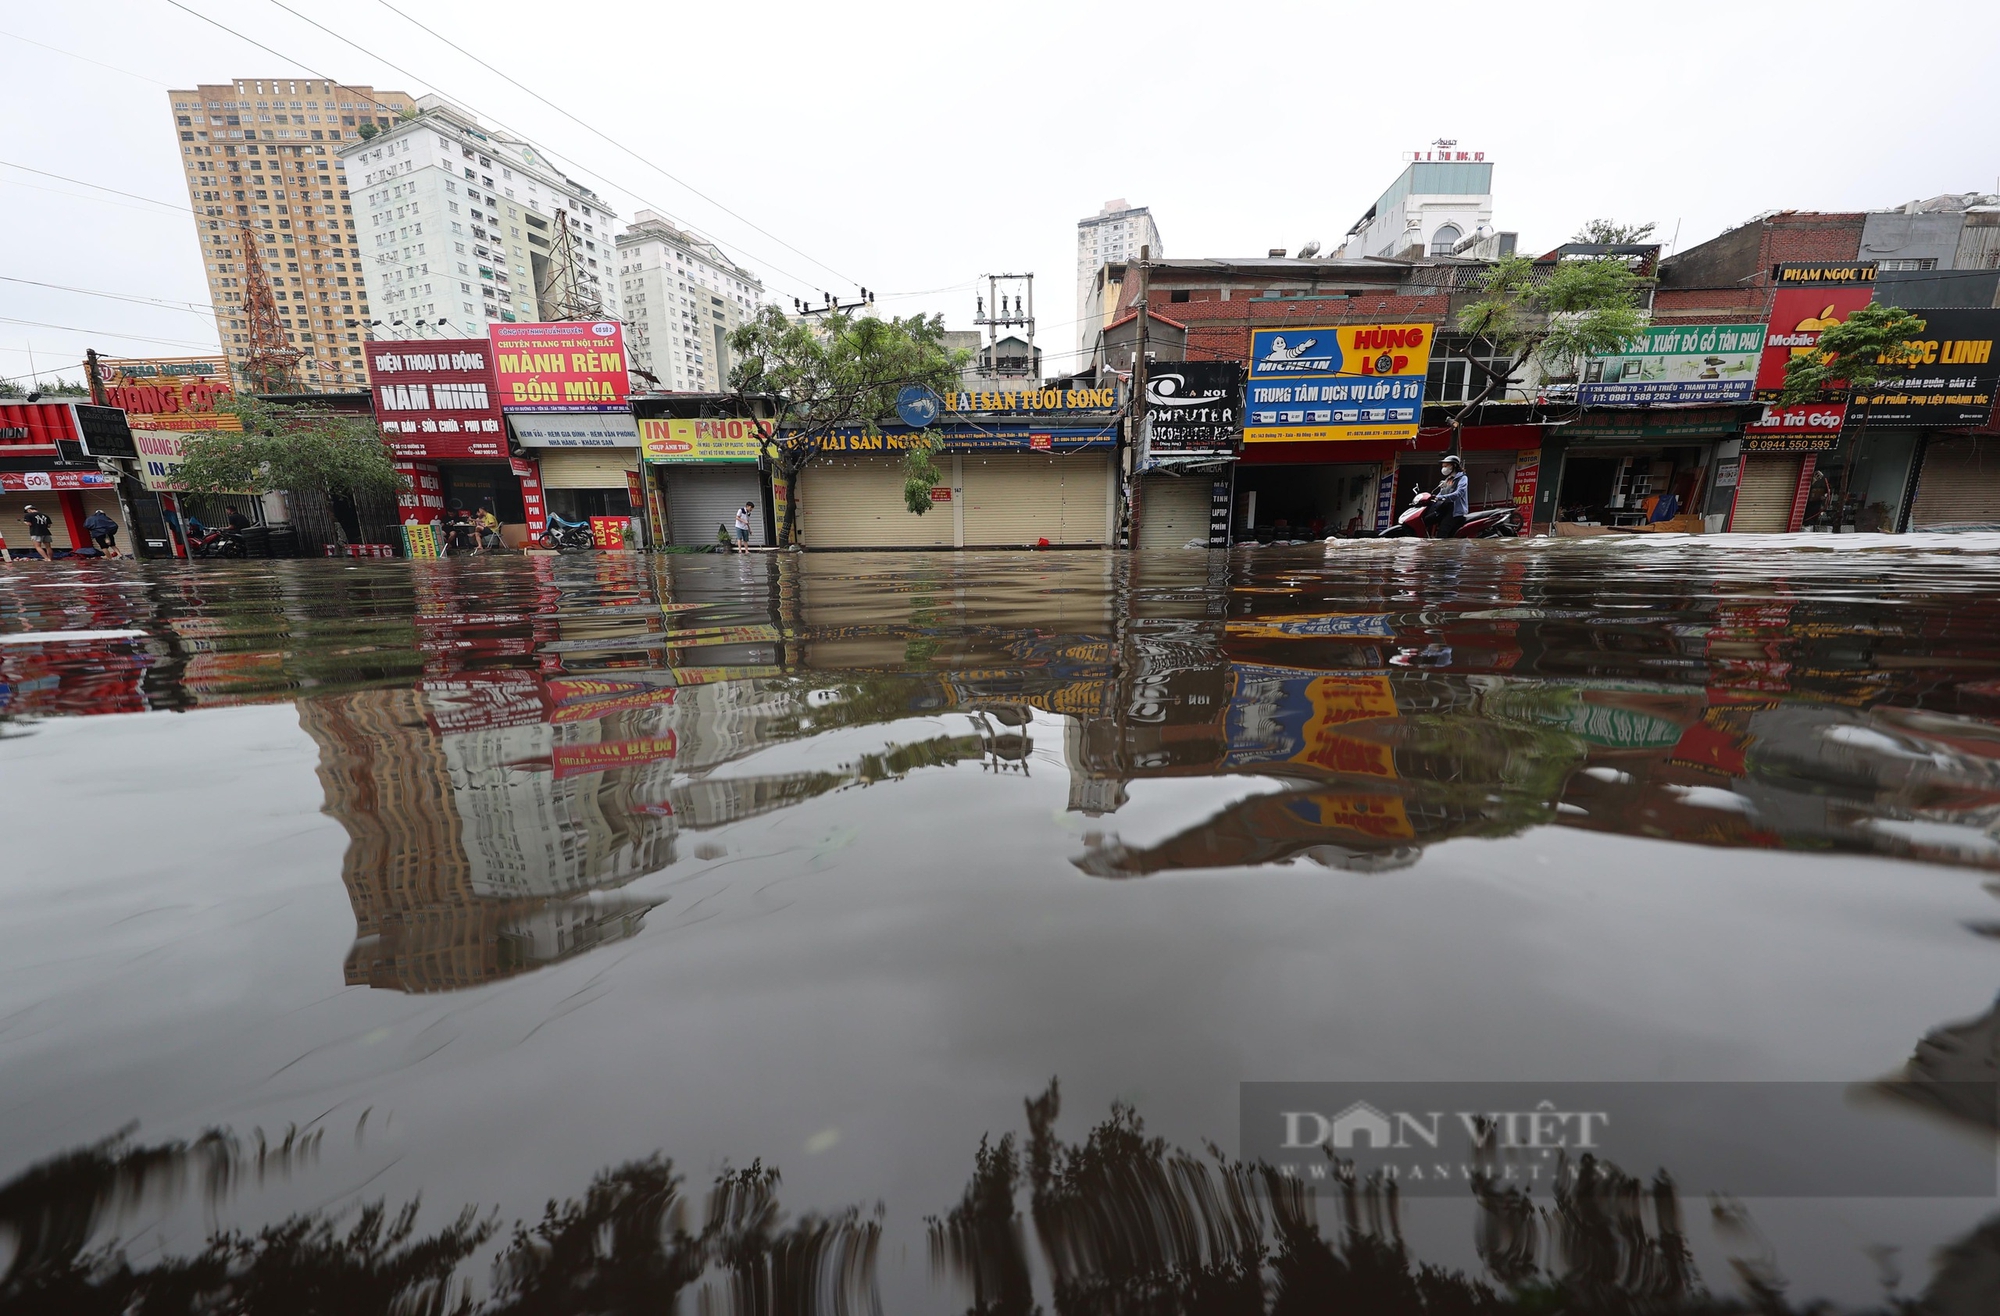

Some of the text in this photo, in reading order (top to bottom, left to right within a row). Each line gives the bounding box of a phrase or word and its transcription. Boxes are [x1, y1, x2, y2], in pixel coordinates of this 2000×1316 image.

[1783, 264, 1879, 284] PHẠM NGỌC TÚ
[499, 327, 517, 336] CÔNG
[1354, 325, 1423, 350] HÙNG
[1652, 328, 1681, 352] XUẤT
[1682, 327, 1699, 351] ĐỒ
[1700, 326, 1717, 351] GỖ
[1718, 330, 1739, 351] TÂN
[1740, 329, 1761, 350] PHÚ
[498, 337, 614, 349] CHUYÊN TRANG TRÍ NỘI THẤT
[1768, 334, 1815, 347] Mobile
[1940, 340, 1993, 364] LINH
[375, 350, 485, 374] ĐIỆN THOẠI DI ĐỘNG
[498, 349, 622, 373] MÀNH RÈM
[1257, 360, 1331, 372] MICHELIN
[512, 375, 617, 402] BỐN MÙA
[1254, 379, 1419, 404] TRUNG TÂM DỊCH VỤ LỐP Ô TÔ
[1628, 384, 1638, 392] 70
[1643, 383, 1658, 392] TÂN
[1684, 382, 1706, 391] THANH
[1707, 381, 1718, 390] TRÌ
[1734, 381, 1747, 391] NỘI
[380, 383, 490, 411] NAM MINH
[1021, 387, 1063, 410] TƯƠI
[1609, 393, 1631, 402] 0981
[1633, 393, 1651, 401] 588
[1653, 392, 1671, 400] 283
[1927, 395, 1944, 406] LIỆU
[1945, 394, 1973, 405] NGÀNH
[1973, 394, 1989, 405] TÓC
[401, 419, 417, 433] BÁN
[422, 418, 438, 433] SỬA
[439, 419, 460, 432] CHỮA
[464, 420, 481, 435] PHỤ
[481, 418, 499, 434] KIỆN
[1783, 411, 1806, 427] Trả
[1808, 411, 1840, 429] Góp
[645, 420, 773, 440] IN PHOTO
[138, 432, 173, 456] QUẢNG
[850, 429, 883, 450] SẢN
[1761, 440, 1830, 449] 0944 550 595
[147, 461, 166, 477] IN
[420, 474, 439, 491] ĐIỆN
[523, 477, 537, 487] KÍNH
[1519, 484, 1530, 493] XE
[421, 494, 444, 510] THOẠI
[525, 495, 539, 504] THAY
[1513, 494, 1533, 504] MÁY
[528, 507, 540, 515] PIN
[1212, 508, 1227, 517] LAPTOP
[528, 521, 543, 530] THAY
[593, 520, 607, 546] RÈM
[606, 520, 621, 545] VẢI
[1211, 522, 1227, 531] PHÍM
